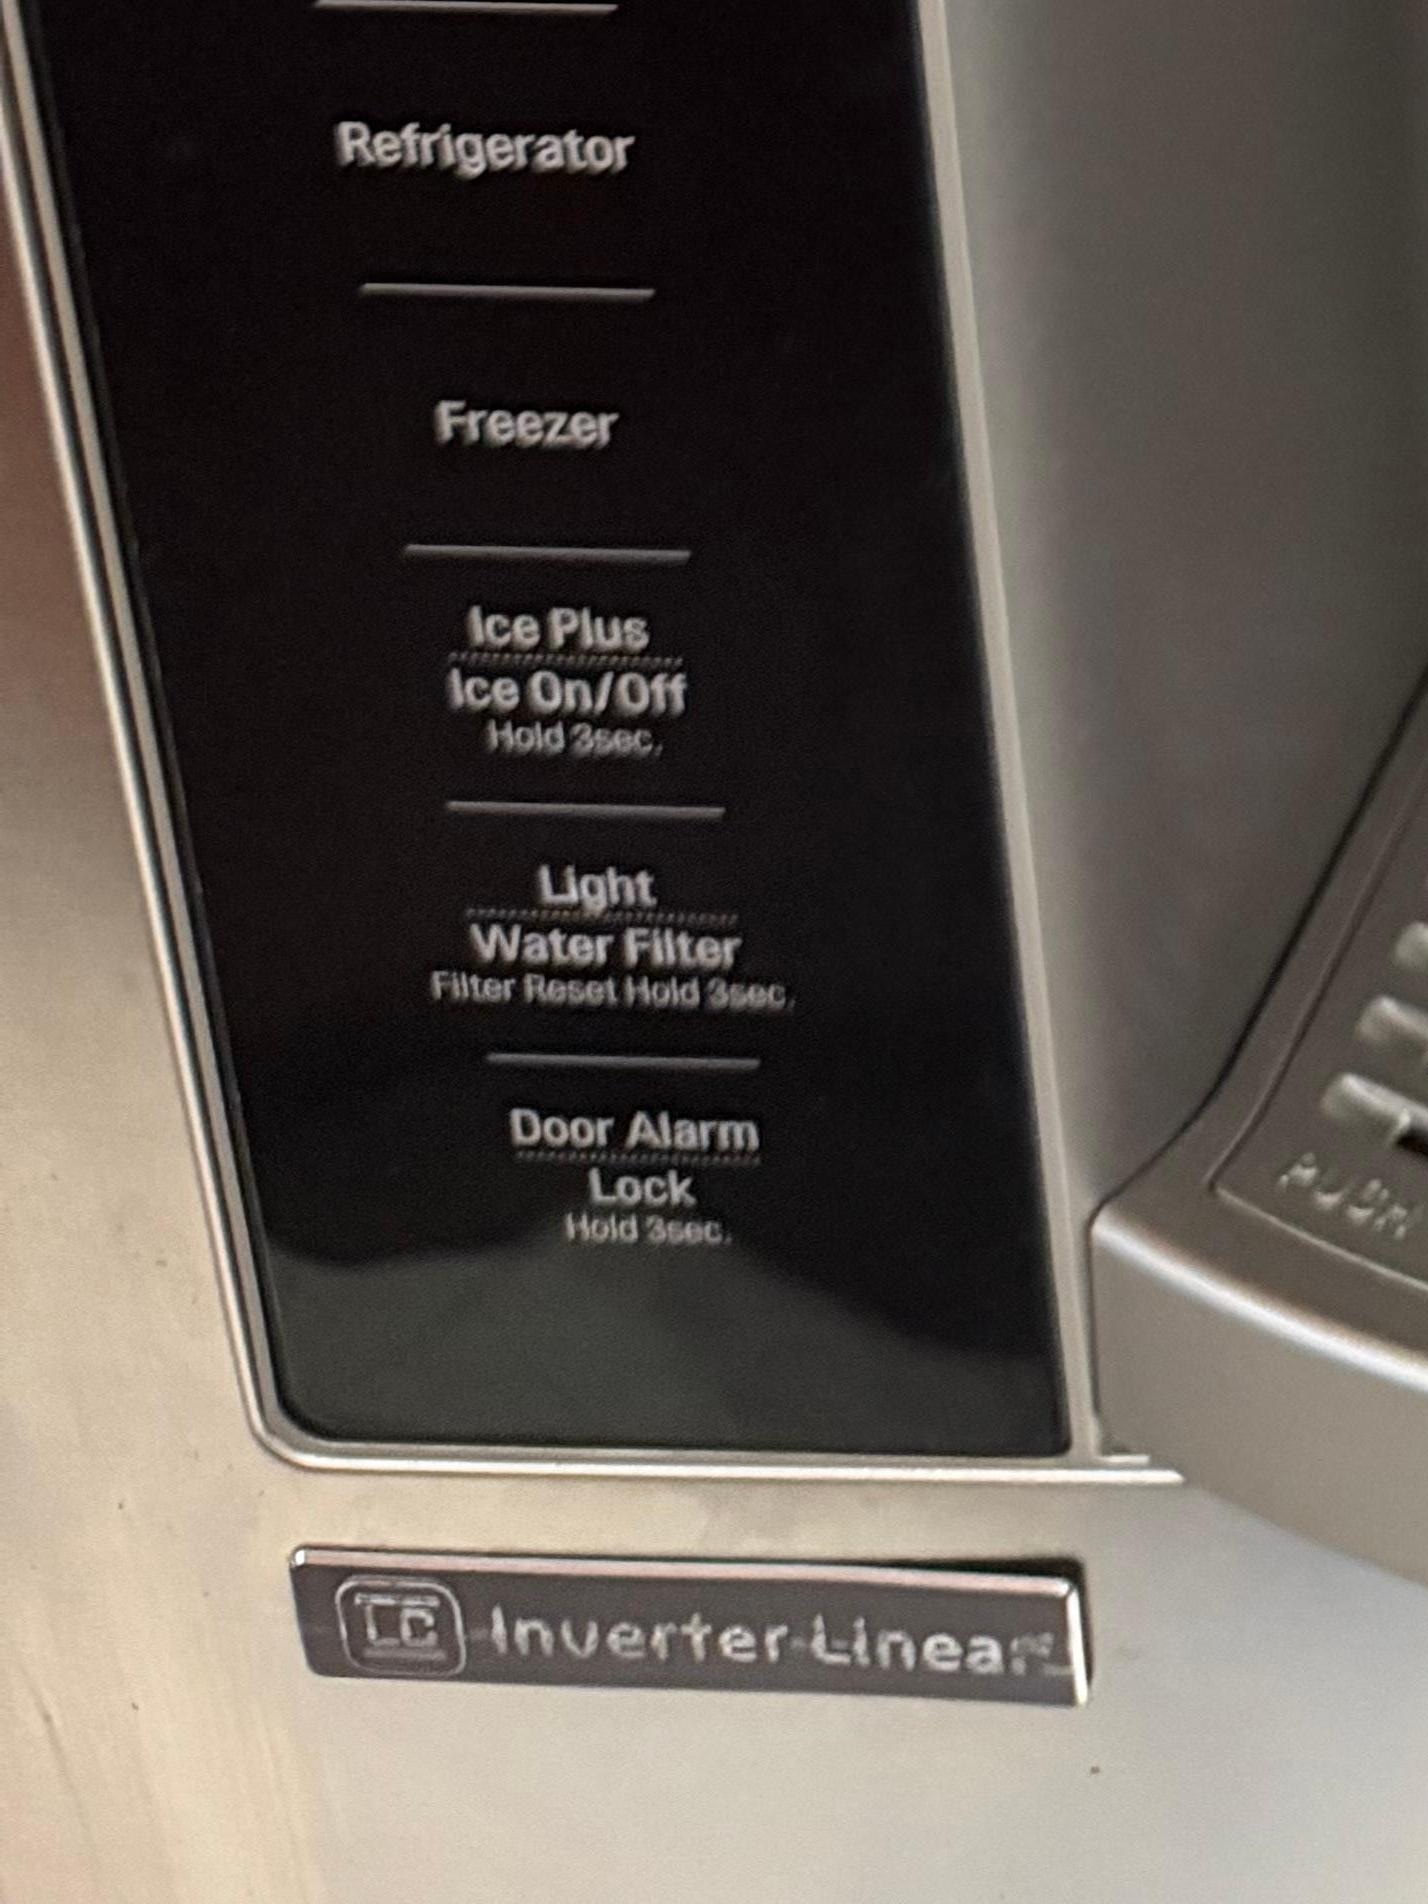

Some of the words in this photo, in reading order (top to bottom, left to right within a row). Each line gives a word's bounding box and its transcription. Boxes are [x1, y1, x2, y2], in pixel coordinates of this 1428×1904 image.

[335, 121, 636, 180] Refrigerator
[435, 400, 620, 447] Freezer
[467, 605, 540, 649] Ice
[548, 607, 650, 650] Plus
[447, 668, 519, 711] Ice
[530, 670, 688, 717] On/Off
[485, 721, 565, 754] Hold
[538, 865, 656, 913] Light
[469, 924, 613, 969] Water
[624, 928, 743, 972] Filter
[432, 971, 516, 1003] Filter
[523, 973, 618, 1007] Reset
[624, 975, 700, 1009] Hold
[510, 1108, 613, 1148] Door
[626, 1109, 760, 1150] Alarm
[588, 1167, 697, 1208] Lock
[565, 1213, 640, 1243] Hold
[490, 1604, 790, 1666] Inverter
